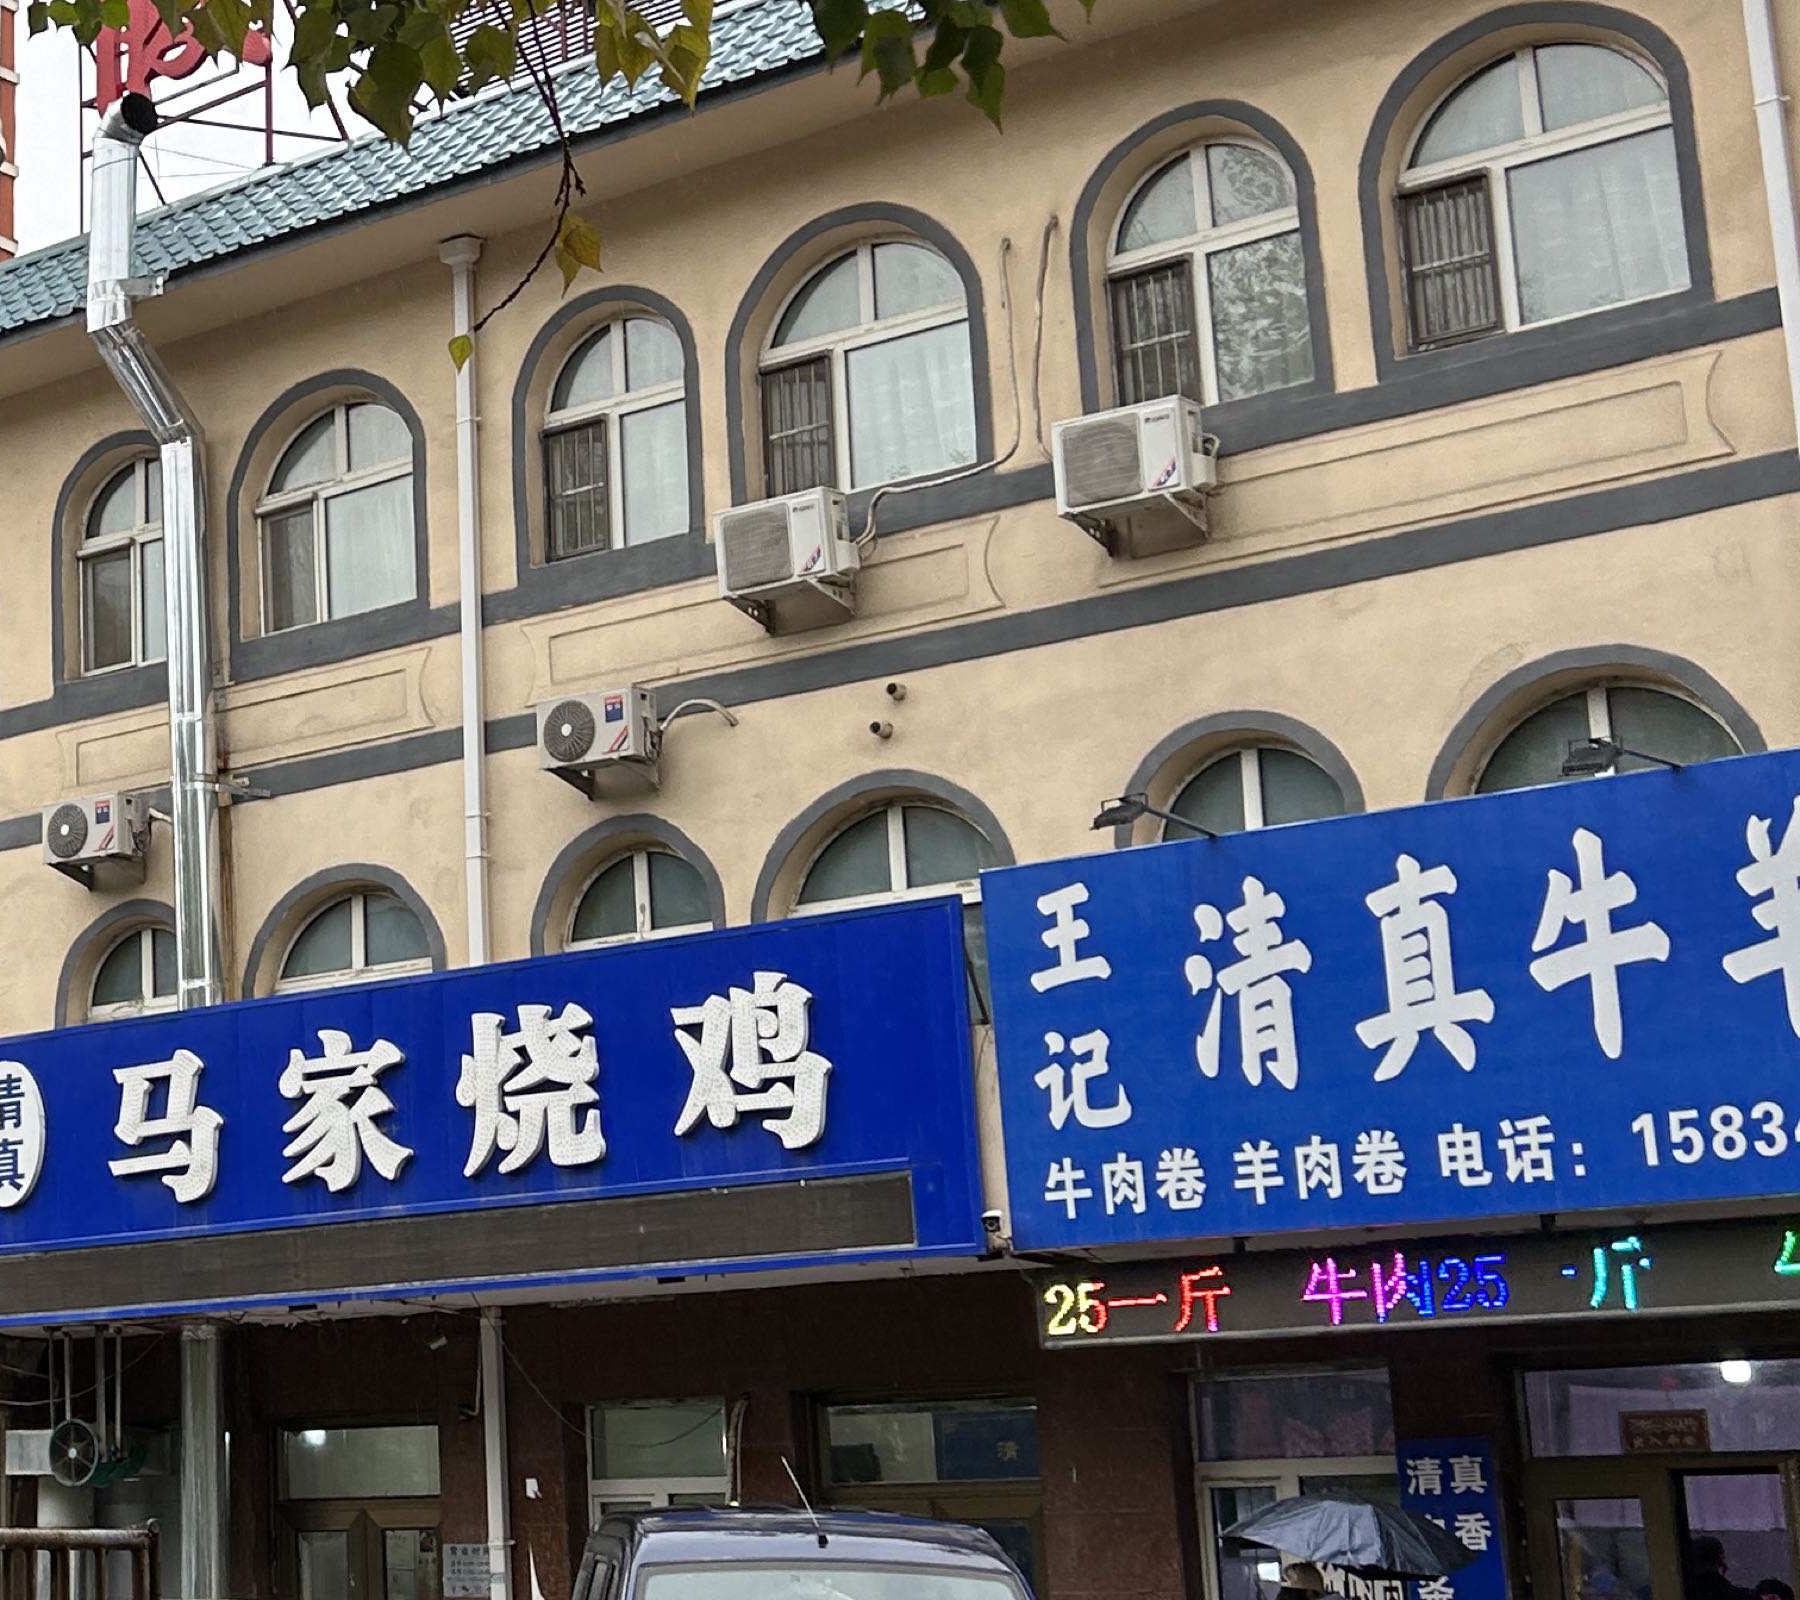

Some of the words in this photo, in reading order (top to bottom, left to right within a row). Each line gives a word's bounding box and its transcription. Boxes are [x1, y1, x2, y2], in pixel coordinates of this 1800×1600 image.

[108, 970, 833, 1203] 马家烧鸡
[1031, 882, 1132, 1131] 王记
[1045, 1148, 1206, 1220] 牛肉卷
[1233, 1129, 1408, 1206] 羊肉卷
[1438, 1115, 1588, 1190] 电话：
[1631, 1100, 1800, 1166] 1583
[1406, 1456, 1488, 1496] 清真
